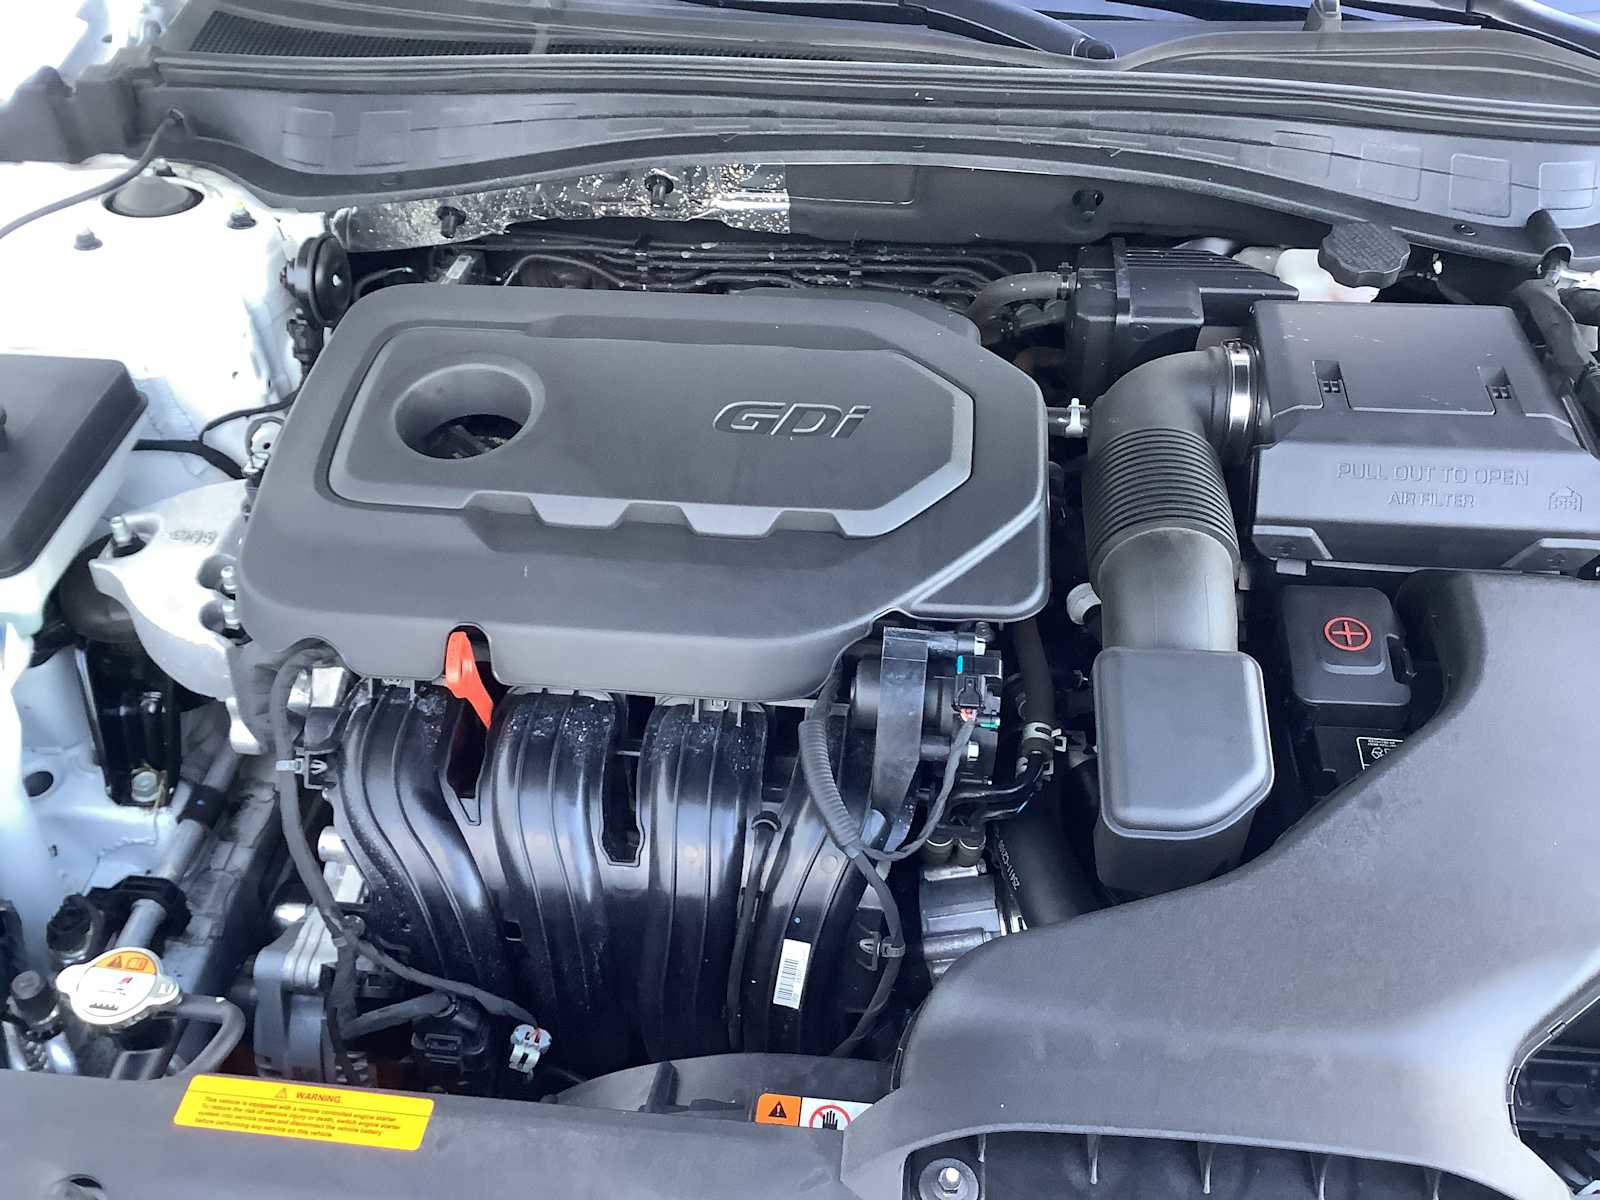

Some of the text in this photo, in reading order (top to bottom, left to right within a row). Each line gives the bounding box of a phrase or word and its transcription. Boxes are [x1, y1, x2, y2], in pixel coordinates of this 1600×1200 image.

[712, 400, 871, 439] GDi
[1337, 462, 1529, 486] PULL OUT TO OPEN
[1388, 490, 1475, 508] AIR FILTER
